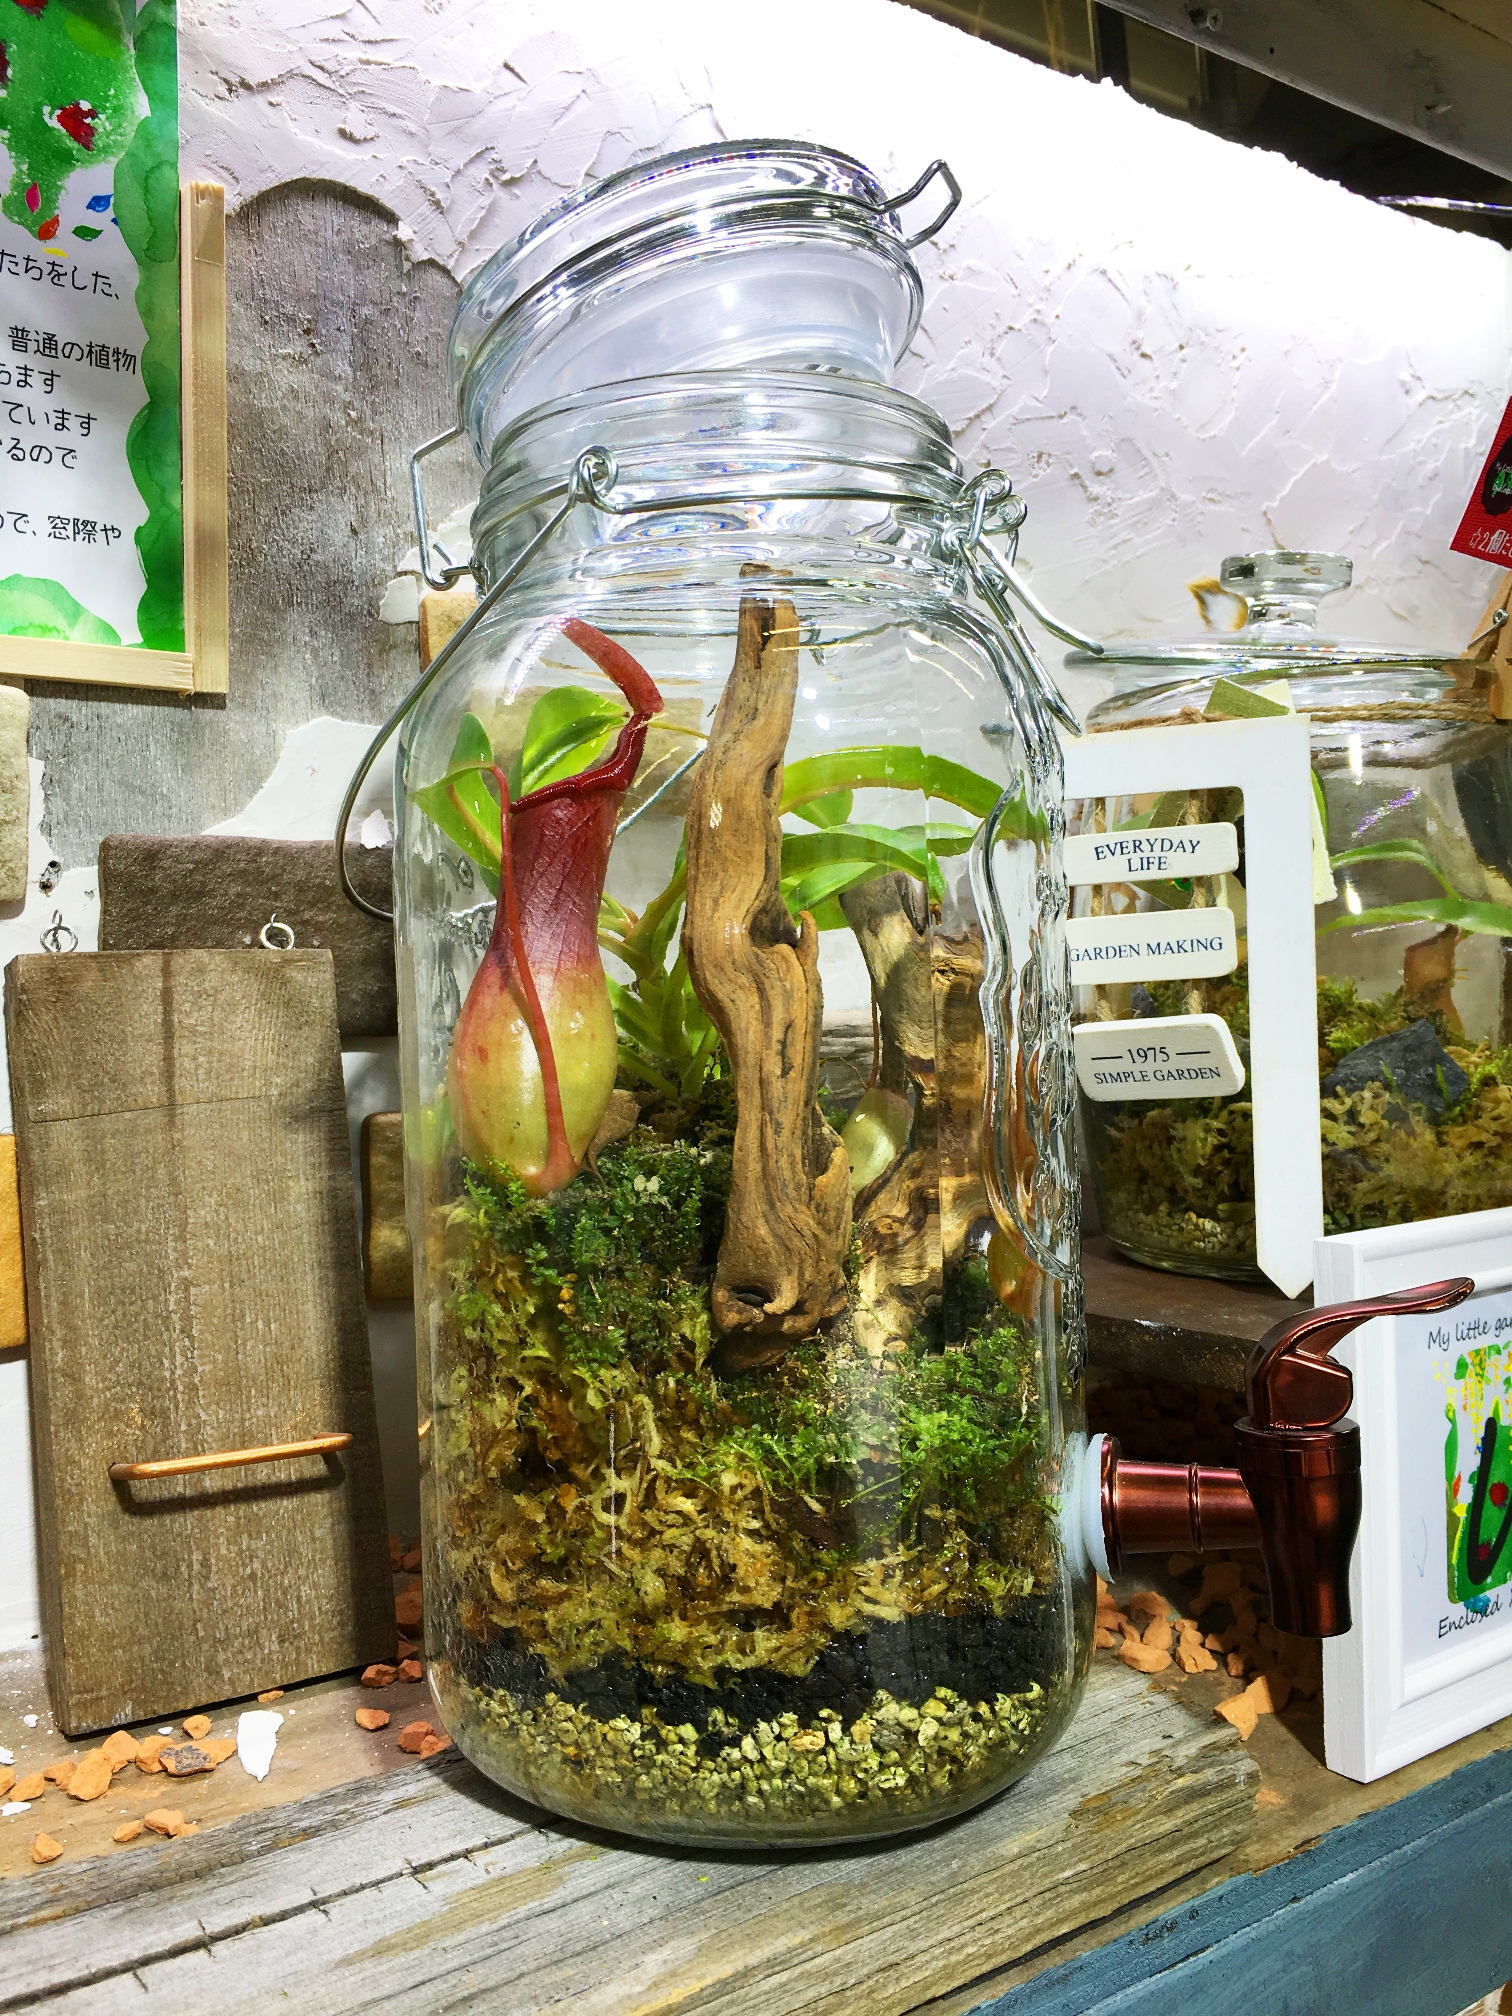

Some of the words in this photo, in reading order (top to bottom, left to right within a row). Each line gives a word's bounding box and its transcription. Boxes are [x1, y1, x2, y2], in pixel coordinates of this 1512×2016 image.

[8, 325, 137, 375] 普通の植物
[2, 400, 97, 437] ています
[0, 437, 77, 470] るので
[0, 511, 121, 545] で、窓際や
[1094, 838, 1200, 860] EVERYDAY
[1127, 856, 1168, 872] LIFE
[1070, 944, 1140, 962] GARDEN
[1146, 937, 1223, 956] MAKING
[1126, 1046, 1170, 1064] 1975
[1094, 1070, 1150, 1084] SIMPLE
[1153, 1067, 1221, 1082] GARDEN
[1428, 1326, 1450, 1352] My
[1455, 1317, 1491, 1341] little
[1494, 1317, 1512, 1338] ga
[1438, 1593, 1503, 1639] Enclosed
